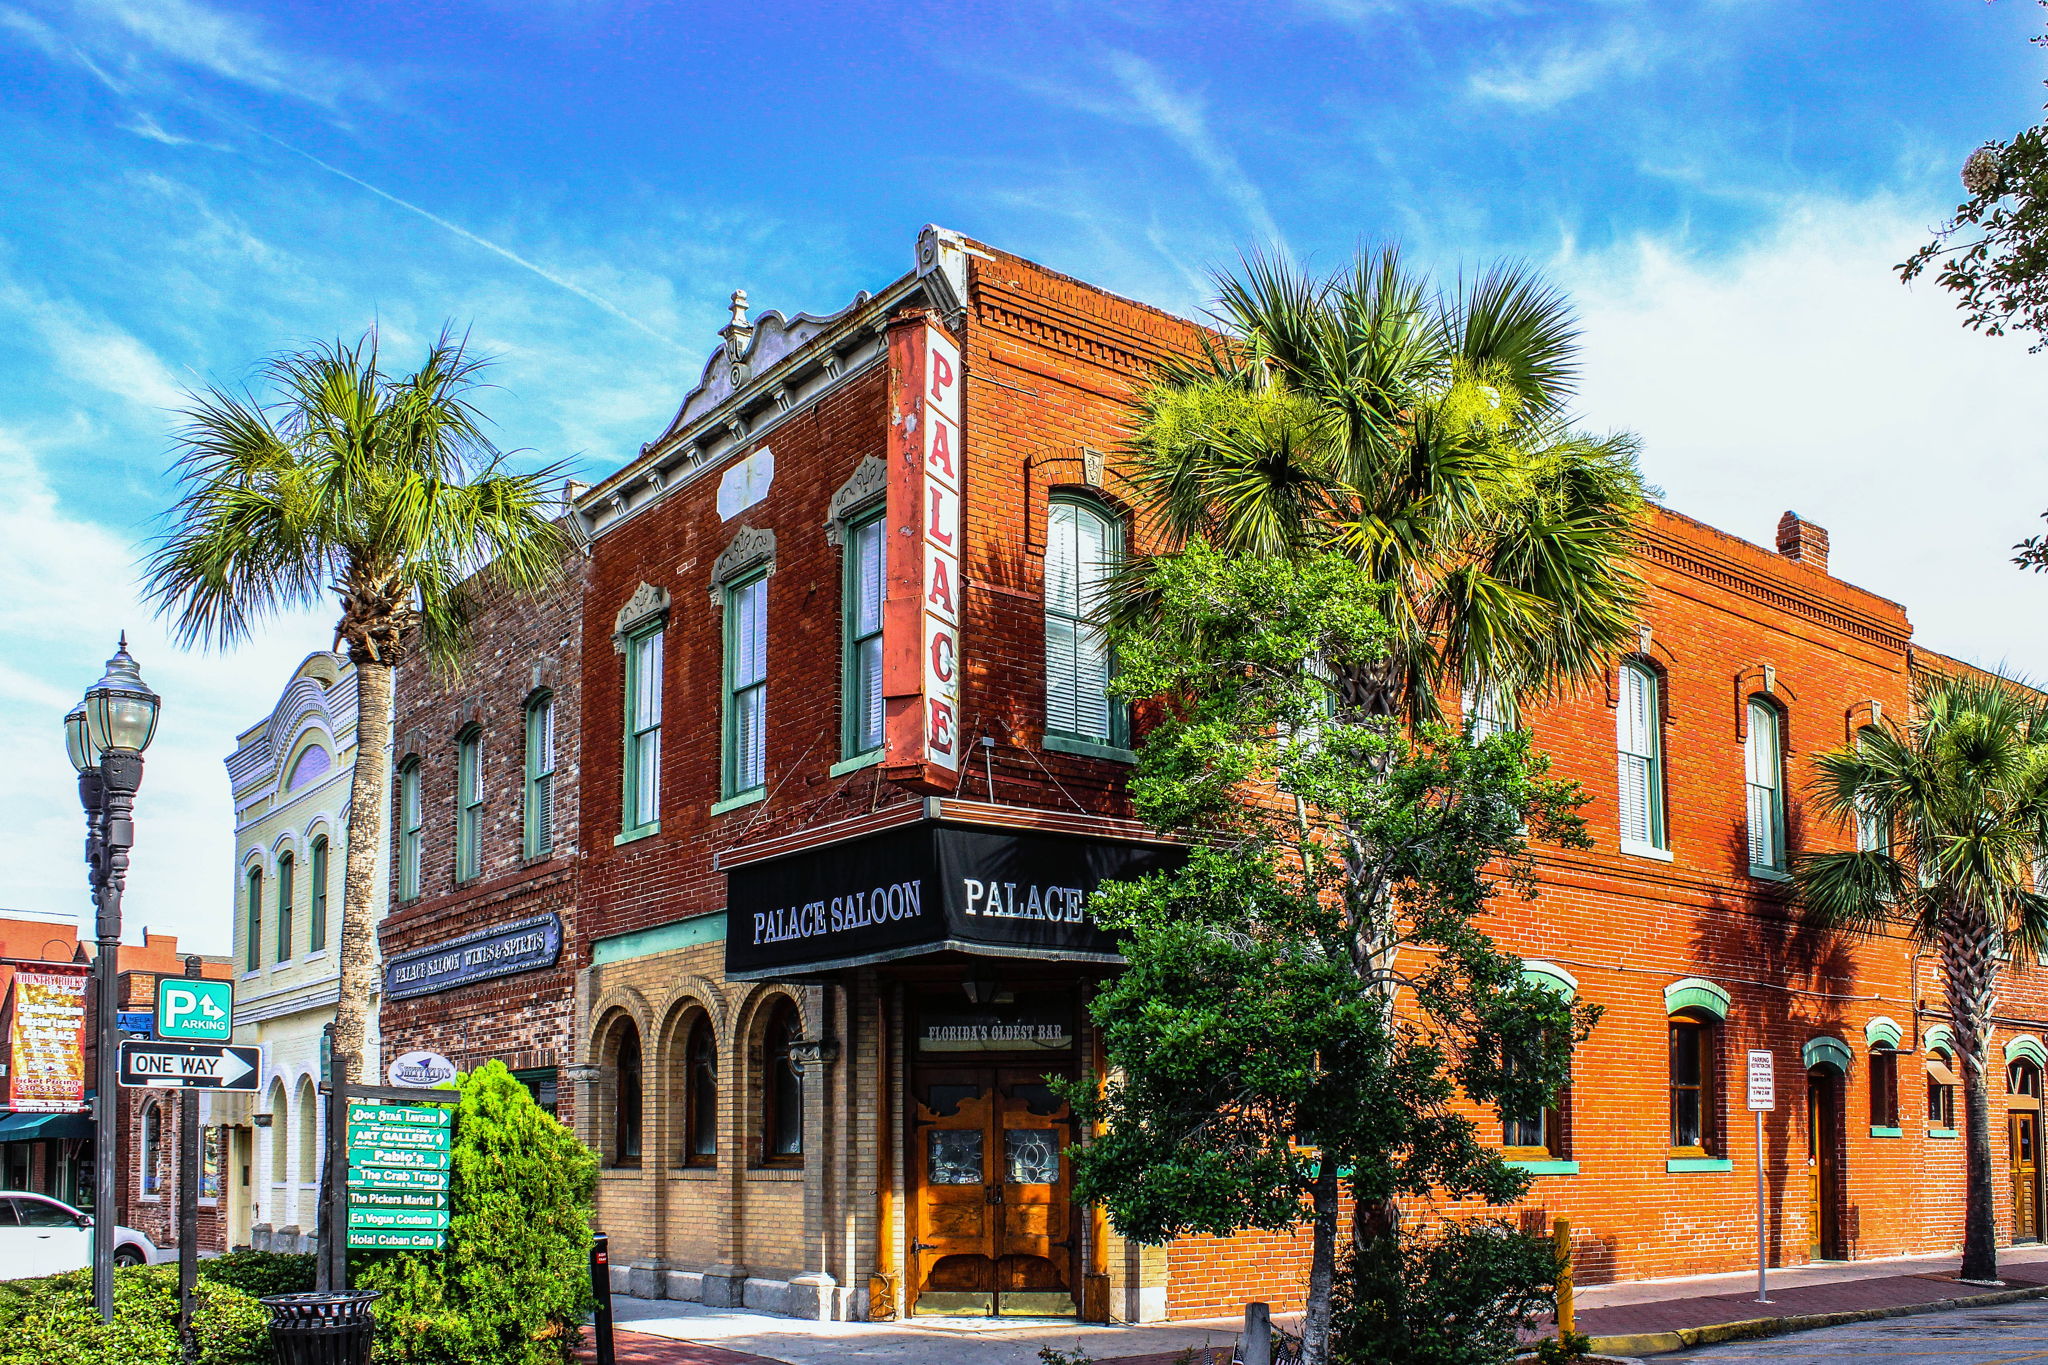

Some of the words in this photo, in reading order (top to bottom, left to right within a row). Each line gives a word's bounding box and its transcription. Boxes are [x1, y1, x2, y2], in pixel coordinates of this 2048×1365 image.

[928, 347, 956, 756] PALACE
[964, 878, 1084, 924] PALACE
[753, 900, 827, 944] PALACE
[830, 880, 921, 932] SALOON
[395, 963, 426, 984] PALACE
[427, 953, 460, 976] SALOON
[464, 942, 494, 966] WINES
[504, 932, 545, 957] SPIRITS
[14, 973, 56, 985] COUNTRY
[58, 976, 86, 986] ROCKS
[165, 989, 226, 1031] PARKING
[928, 1025, 988, 1041] FLORIDA'S
[991, 1024, 1034, 1040] OLDEST
[1038, 1024, 1062, 1040] BAR
[136, 1056, 174, 1072] ONE
[181, 1058, 219, 1075] WAY
[356, 1131, 379, 1140] ART
[382, 1132, 435, 1143] GALLERY
[374, 1150, 424, 1162] Pablo's
[360, 1170, 381, 1180] The
[384, 1171, 410, 1181] Crab
[412, 1172, 437, 1184] Trap
[350, 1193, 368, 1203] The
[369, 1194, 402, 1204] Pickers
[403, 1195, 434, 1205] Market
[351, 1213, 363, 1223] En
[365, 1214, 395, 1226] Vogue
[396, 1214, 433, 1225] Couture
[350, 1234, 376, 1244] Hola!
[378, 1235, 410, 1245] Cuban
[412, 1236, 434, 1246] Cafe
